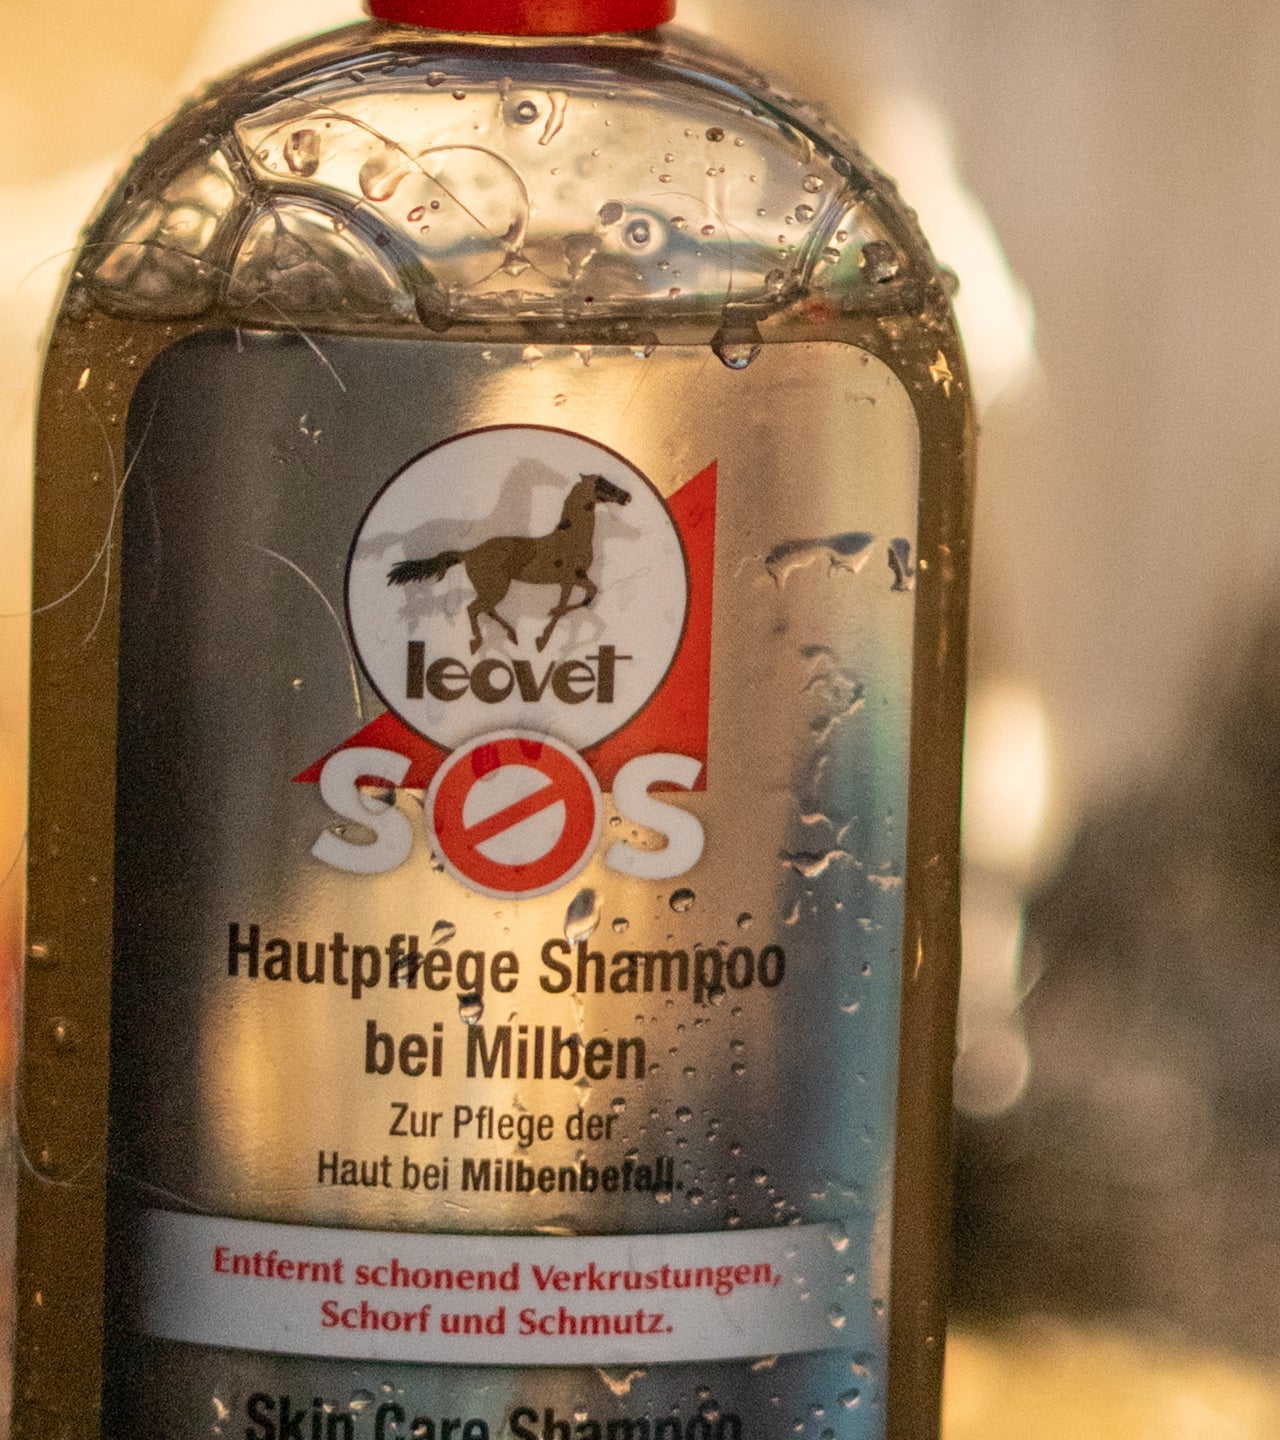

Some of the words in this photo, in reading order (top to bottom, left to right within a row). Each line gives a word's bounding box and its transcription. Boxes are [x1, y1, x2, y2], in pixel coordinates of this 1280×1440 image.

[405, 640, 633, 704] leovet
[227, 922, 520, 1000] Hautpflege
[539, 938, 786, 1004] Shampoo
[364, 1020, 444, 1077] bei
[466, 1024, 646, 1080] Milben
[389, 1102, 443, 1138] Zur
[453, 1104, 554, 1148] Pflege
[566, 1107, 618, 1141] der
[318, 1150, 393, 1188] Haut
[403, 1156, 449, 1190] bei
[461, 1156, 684, 1193] Milbenbefall.
[213, 1247, 344, 1284] Entfernt
[355, 1258, 520, 1292] schonend
[531, 1262, 783, 1297] Verkrustungen,
[321, 1300, 431, 1333] Schorf
[440, 1306, 507, 1336] und
[519, 1306, 673, 1336] Schmutz.
